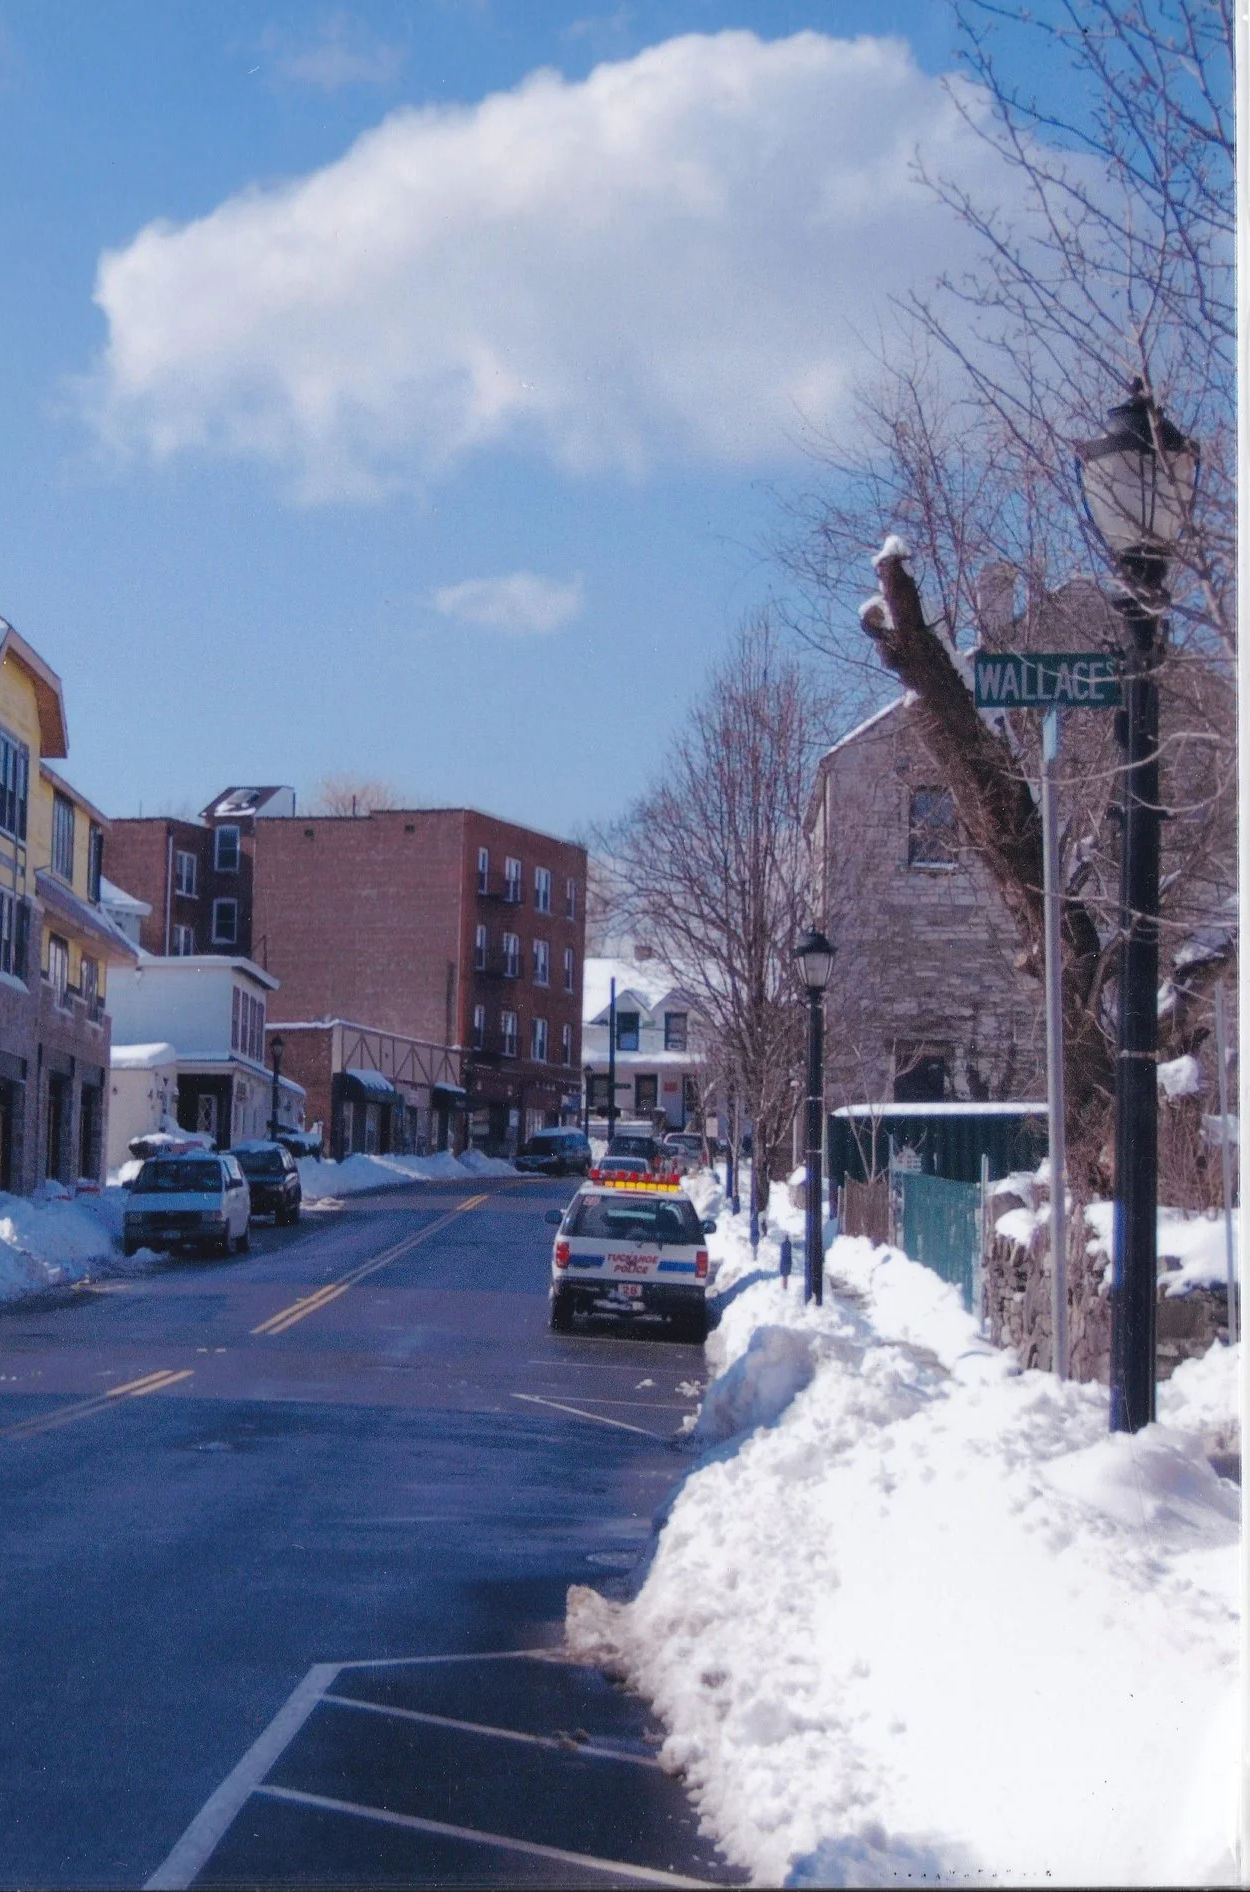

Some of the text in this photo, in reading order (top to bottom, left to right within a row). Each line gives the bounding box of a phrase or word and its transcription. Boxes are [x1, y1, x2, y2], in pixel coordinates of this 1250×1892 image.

[977, 661, 1104, 701] WALLACE
[607, 1253, 659, 1265] TUCKAHOE
[614, 1264, 649, 1275] POLICE
